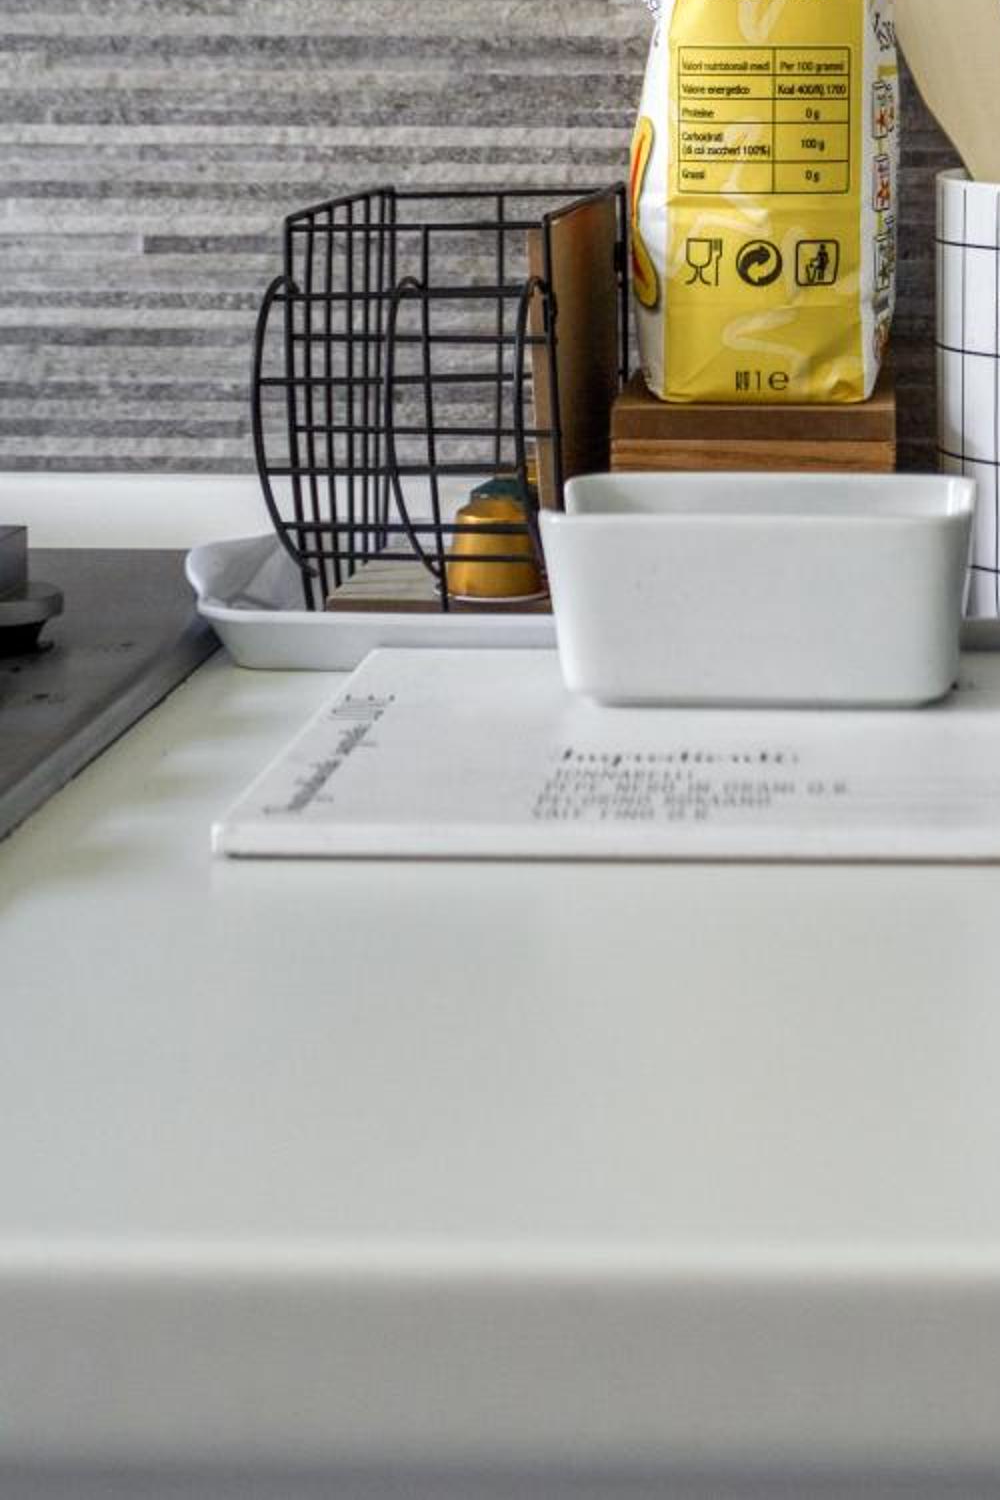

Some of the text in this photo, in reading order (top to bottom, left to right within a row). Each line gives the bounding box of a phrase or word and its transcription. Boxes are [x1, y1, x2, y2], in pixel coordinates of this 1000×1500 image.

[780, 61, 795, 71] Per
[797, 61, 814, 71] 100
[682, 84, 751, 97] Valore energetico
[682, 107, 715, 118] Proteine
[805, 107, 812, 118] 0
[801, 138, 817, 149] 100
[805, 169, 812, 180] 0
